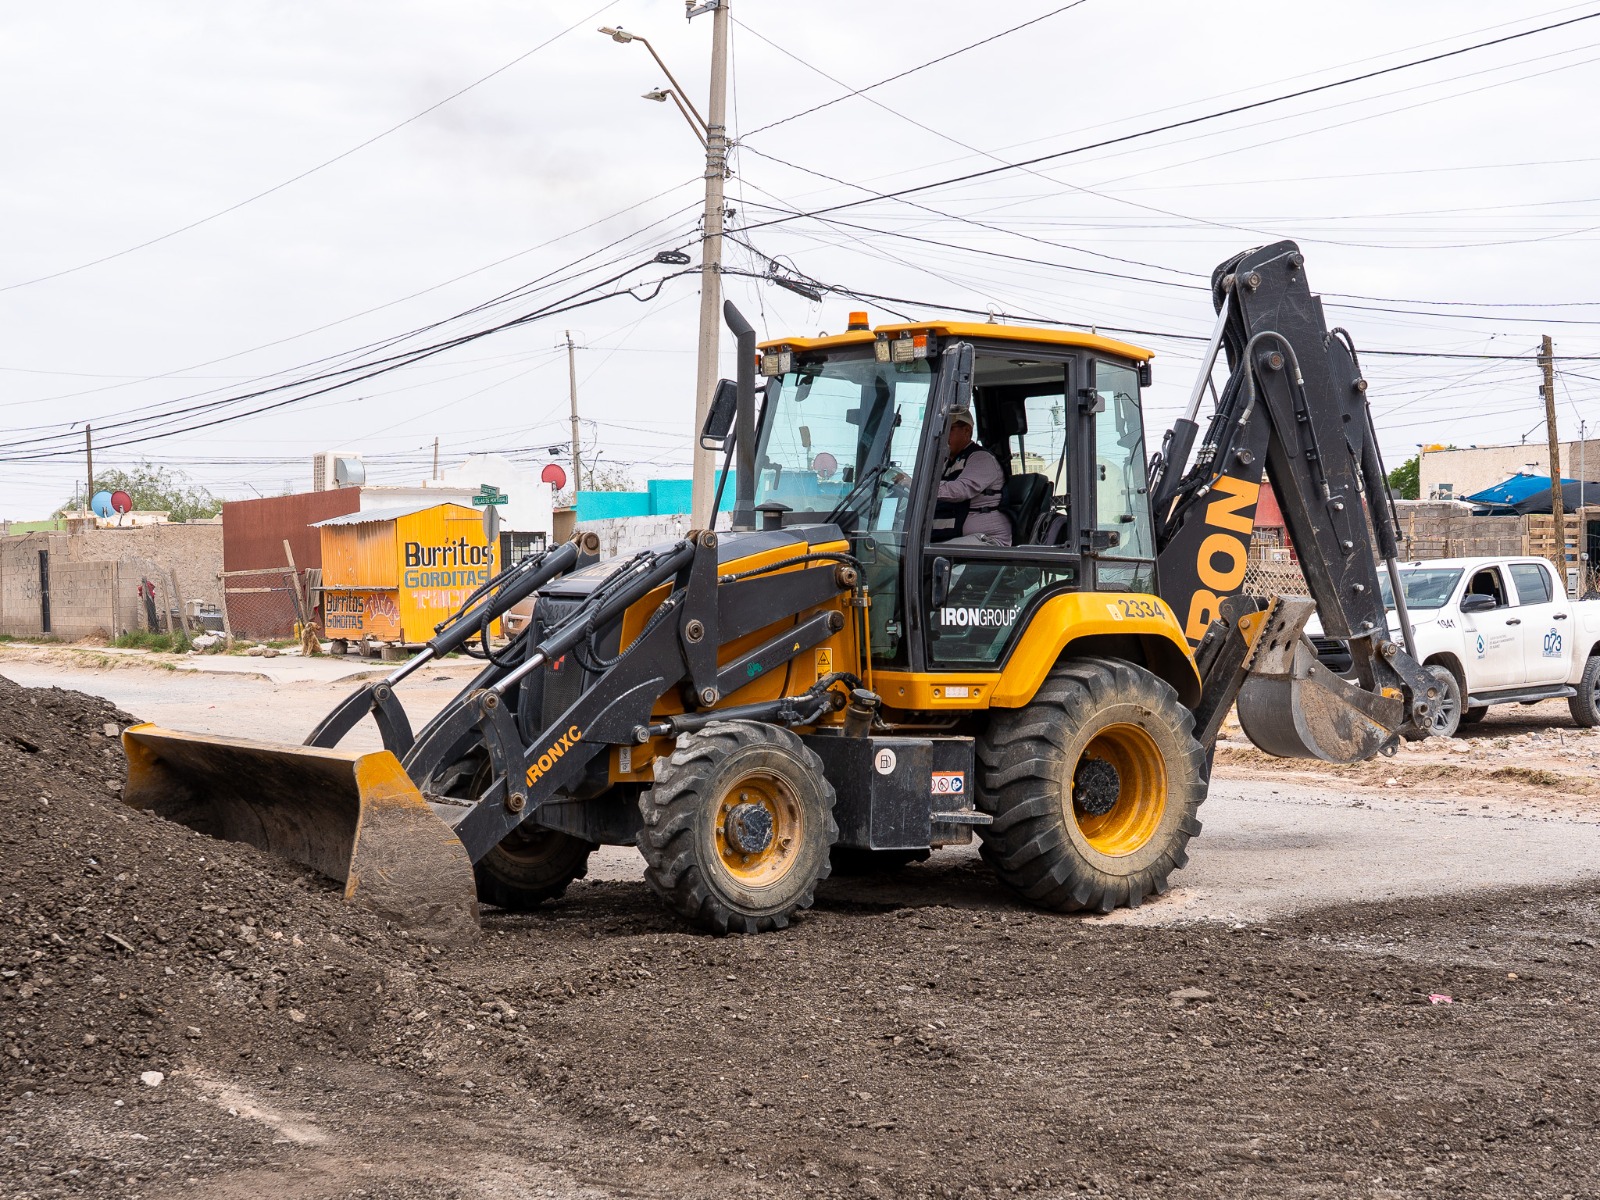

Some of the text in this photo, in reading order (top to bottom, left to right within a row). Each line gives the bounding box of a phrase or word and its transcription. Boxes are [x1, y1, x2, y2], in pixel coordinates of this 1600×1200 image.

[404, 535, 494, 568] Burritos
[1186, 473, 1260, 658] RON
[404, 568, 490, 589] GORDITAS
[326, 591, 364, 613] Burritos
[1117, 599, 1166, 621] 2334
[325, 612, 363, 630] GORDITAS
[940, 607, 1017, 627] IRONGROUP
[1437, 618, 1456, 629] 1941
[1543, 633, 1562, 652] 073
